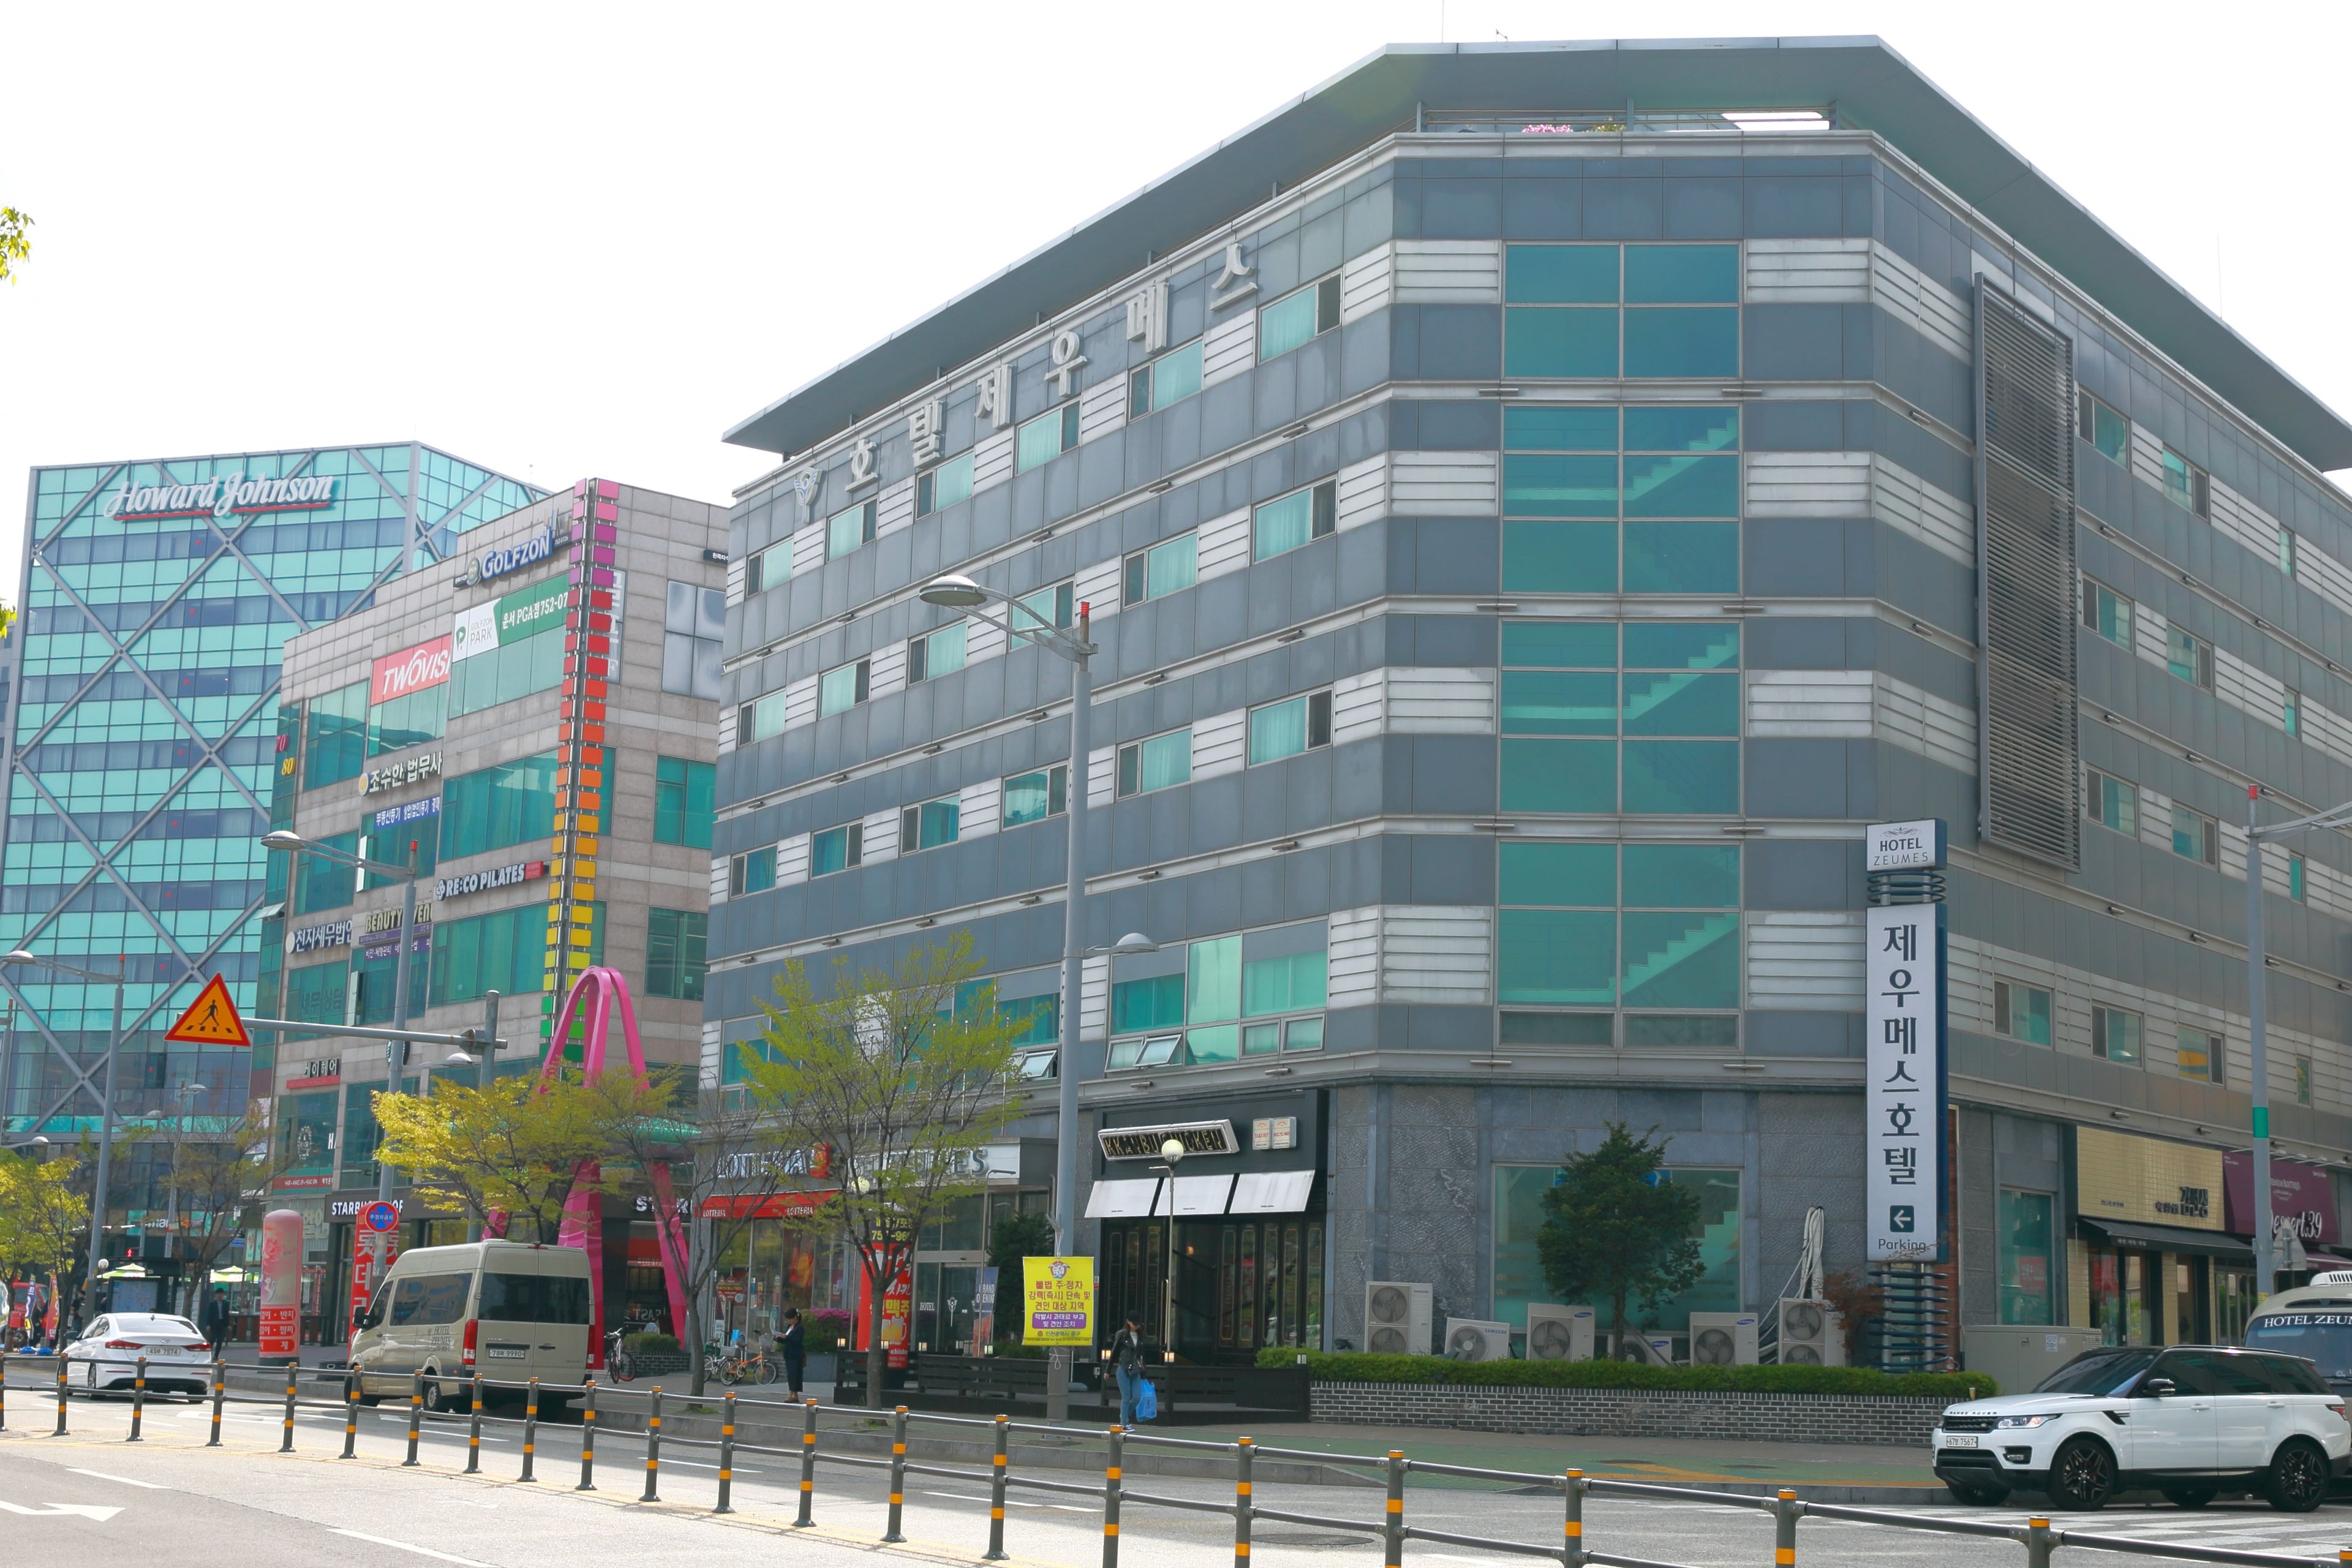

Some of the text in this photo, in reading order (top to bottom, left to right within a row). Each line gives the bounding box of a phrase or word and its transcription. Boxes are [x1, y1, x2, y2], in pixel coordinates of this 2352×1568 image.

[104, 471, 334, 518] Howard Johnson
[481, 524, 551, 578] GOLFZON
[470, 617, 492, 631] GOLFZON
[470, 627, 492, 646] PARK
[281, 757, 295, 775] 80
[369, 751, 442, 793] 조수한 법무사
[1880, 837, 1923, 852] HOTEL
[1874, 852, 1928, 865] ZEUMES
[446, 873, 478, 897] RE:CO
[480, 863, 525, 890] PILATES
[366, 908, 404, 933] BEAUTY
[703, 1209, 726, 1218] LOTTERIA
[786, 1206, 813, 1216] LOTTERIA
[1878, 1238, 1926, 1253] Parking
[1036, 1280, 1052, 1289] 불법
[1066, 1291, 1080, 1300] 단속
[1084, 1291, 1091, 1300] 및
[919, 1302, 935, 1311] HOTEL
[1035, 1302, 1084, 1311] 견인 대상 지역
[2264, 1315, 2312, 1328] HOTEL
[1960, 1438, 1975, 1446] 7567
